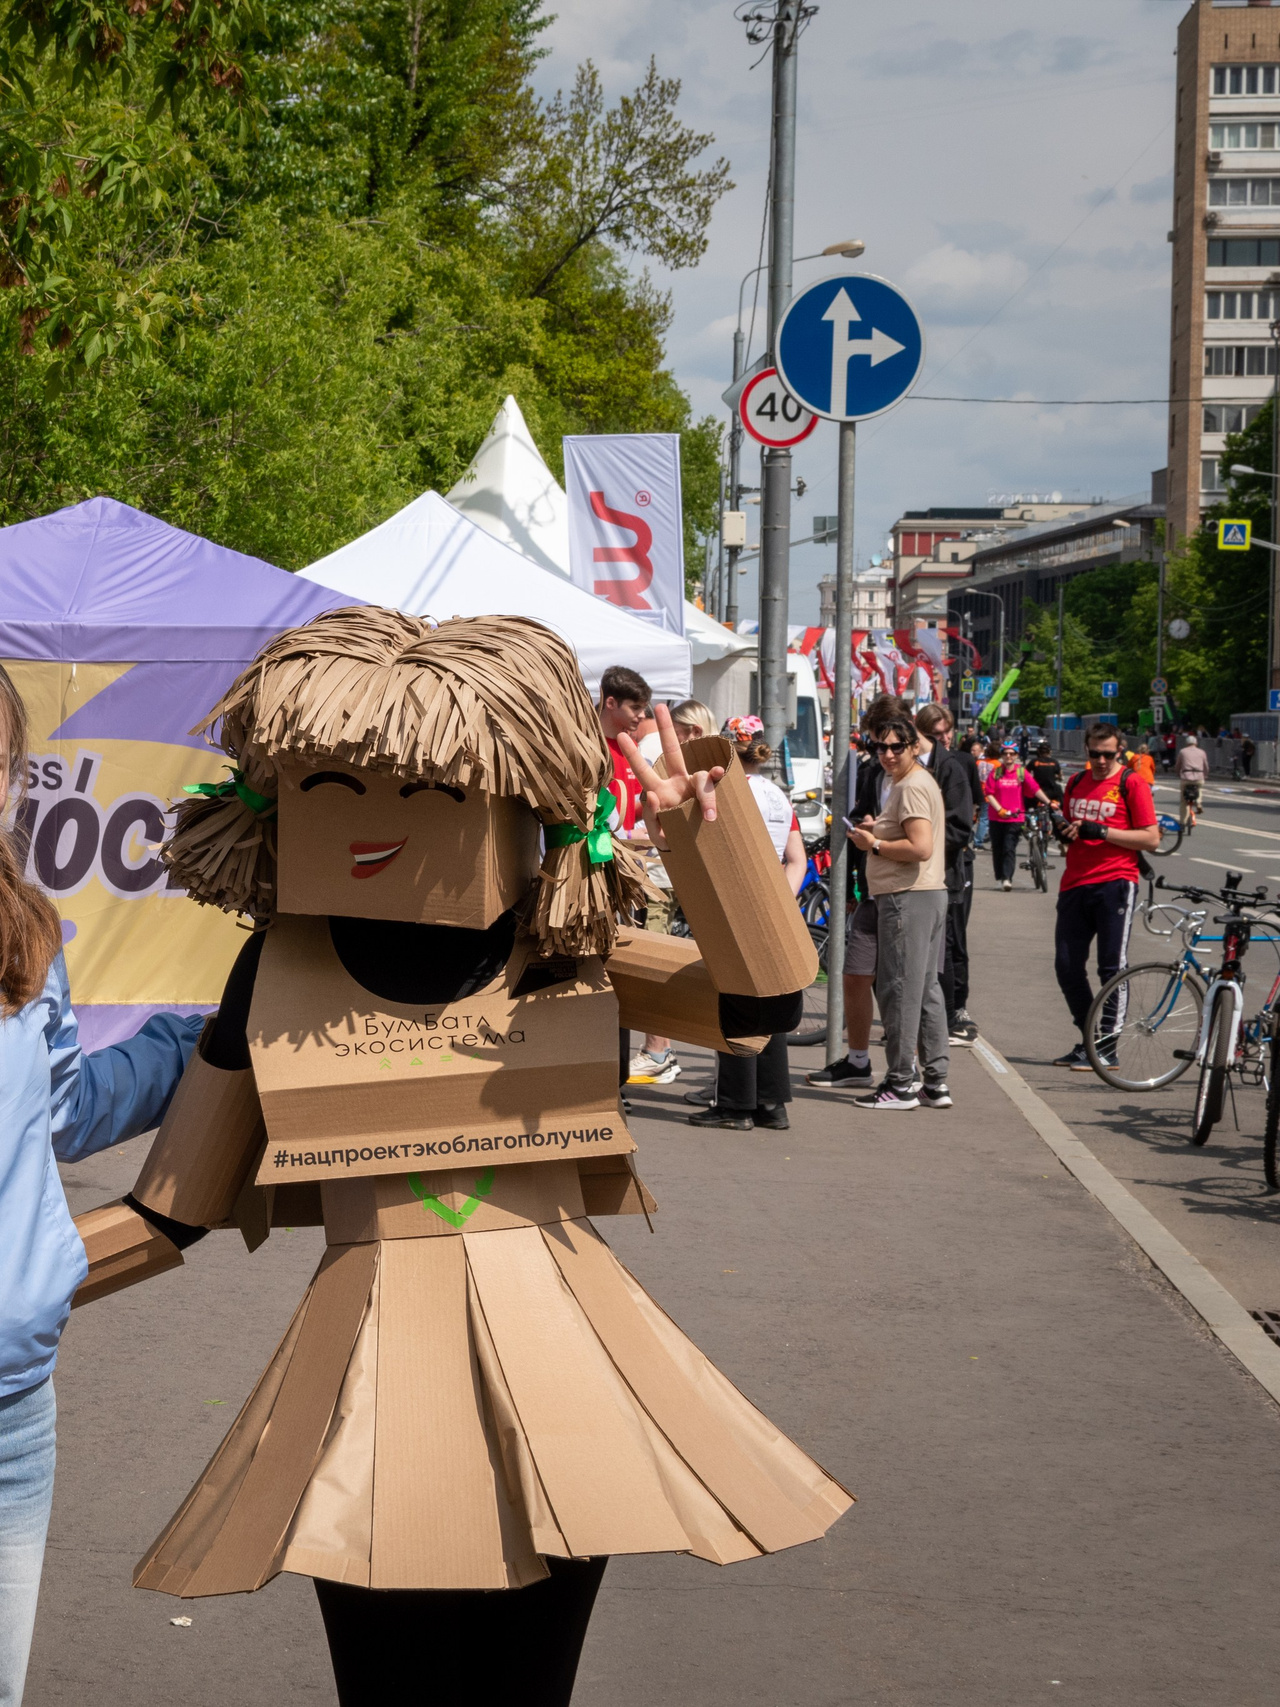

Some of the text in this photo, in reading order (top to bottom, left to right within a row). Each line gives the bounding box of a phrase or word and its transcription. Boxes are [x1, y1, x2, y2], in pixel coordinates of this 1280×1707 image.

[756, 392, 802, 423] 40
[365, 1013, 491, 1038] БумБатл
[334, 1030, 526, 1057] экосистема
[273, 1124, 614, 1169] #нацпроектэкоблагополучие
